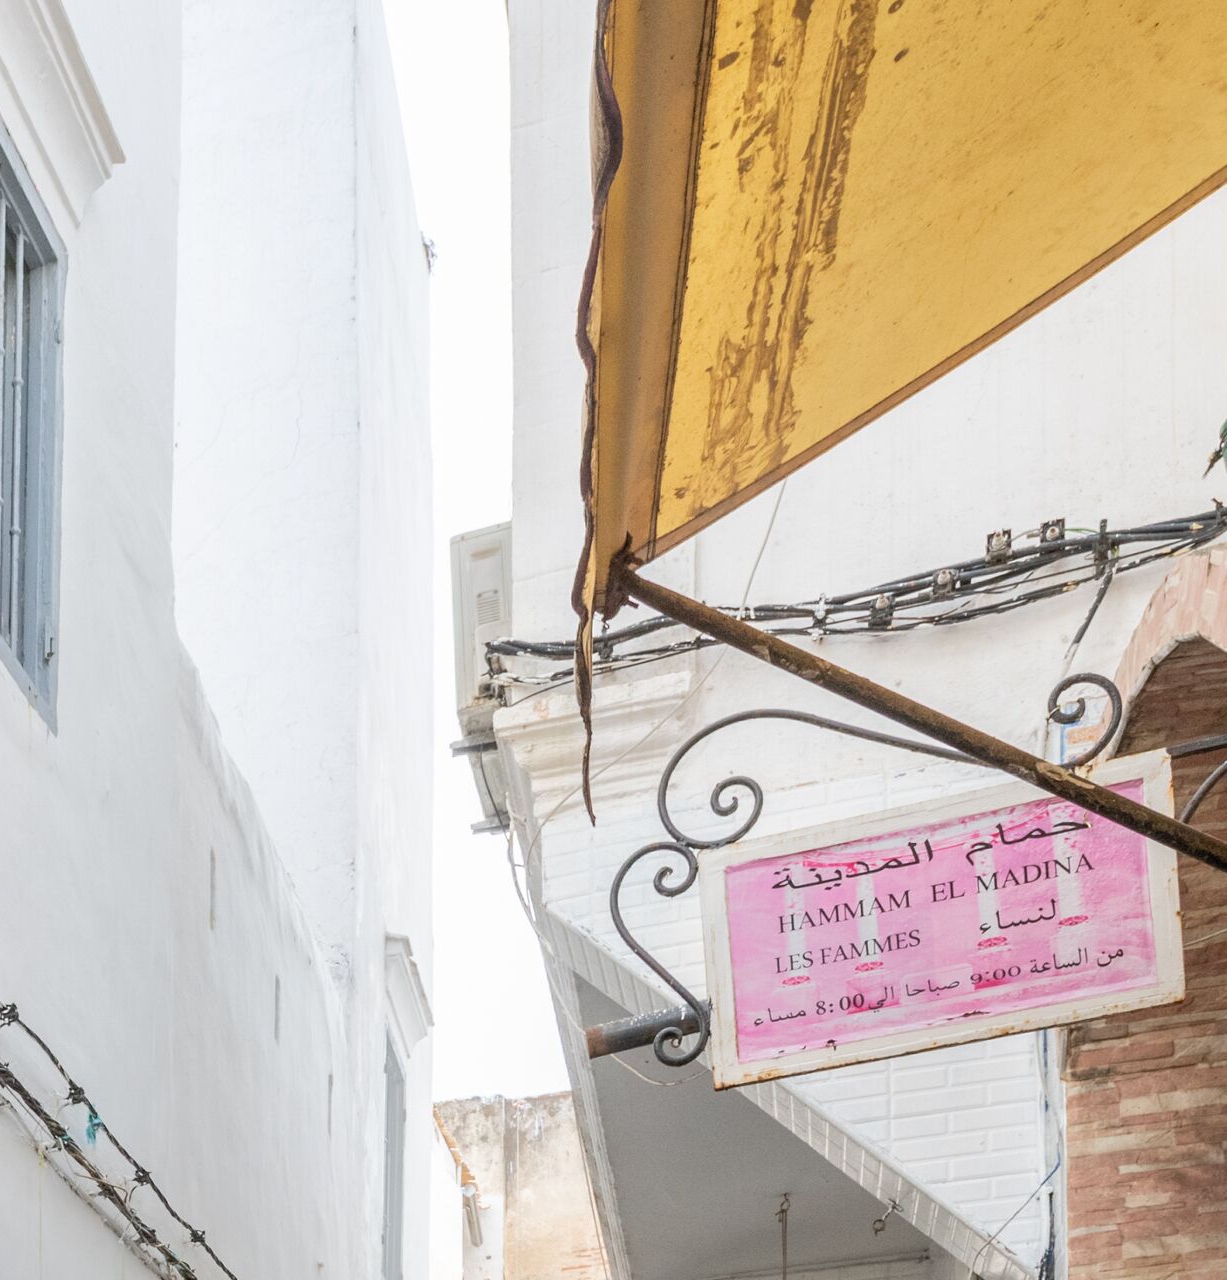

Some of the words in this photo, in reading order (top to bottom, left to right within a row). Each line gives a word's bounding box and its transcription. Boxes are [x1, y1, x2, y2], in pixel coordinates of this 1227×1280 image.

[966, 820, 1092, 864] حمام
[772, 839, 934, 893] المدينة
[778, 889, 912, 934] HAMMAM
[931, 881, 966, 904] EL
[976, 853, 1095, 896] MADINA
[775, 947, 814, 975] LES
[820, 929, 922, 966] FAMMES
[1030, 946, 1089, 975] الساعة
[1096, 948, 1125, 968] من
[906, 978, 961, 1001] صباحا
[970, 965, 1021, 988] 9:00
[754, 1004, 806, 1029] مساء
[815, 993, 865, 1017] 8:00
